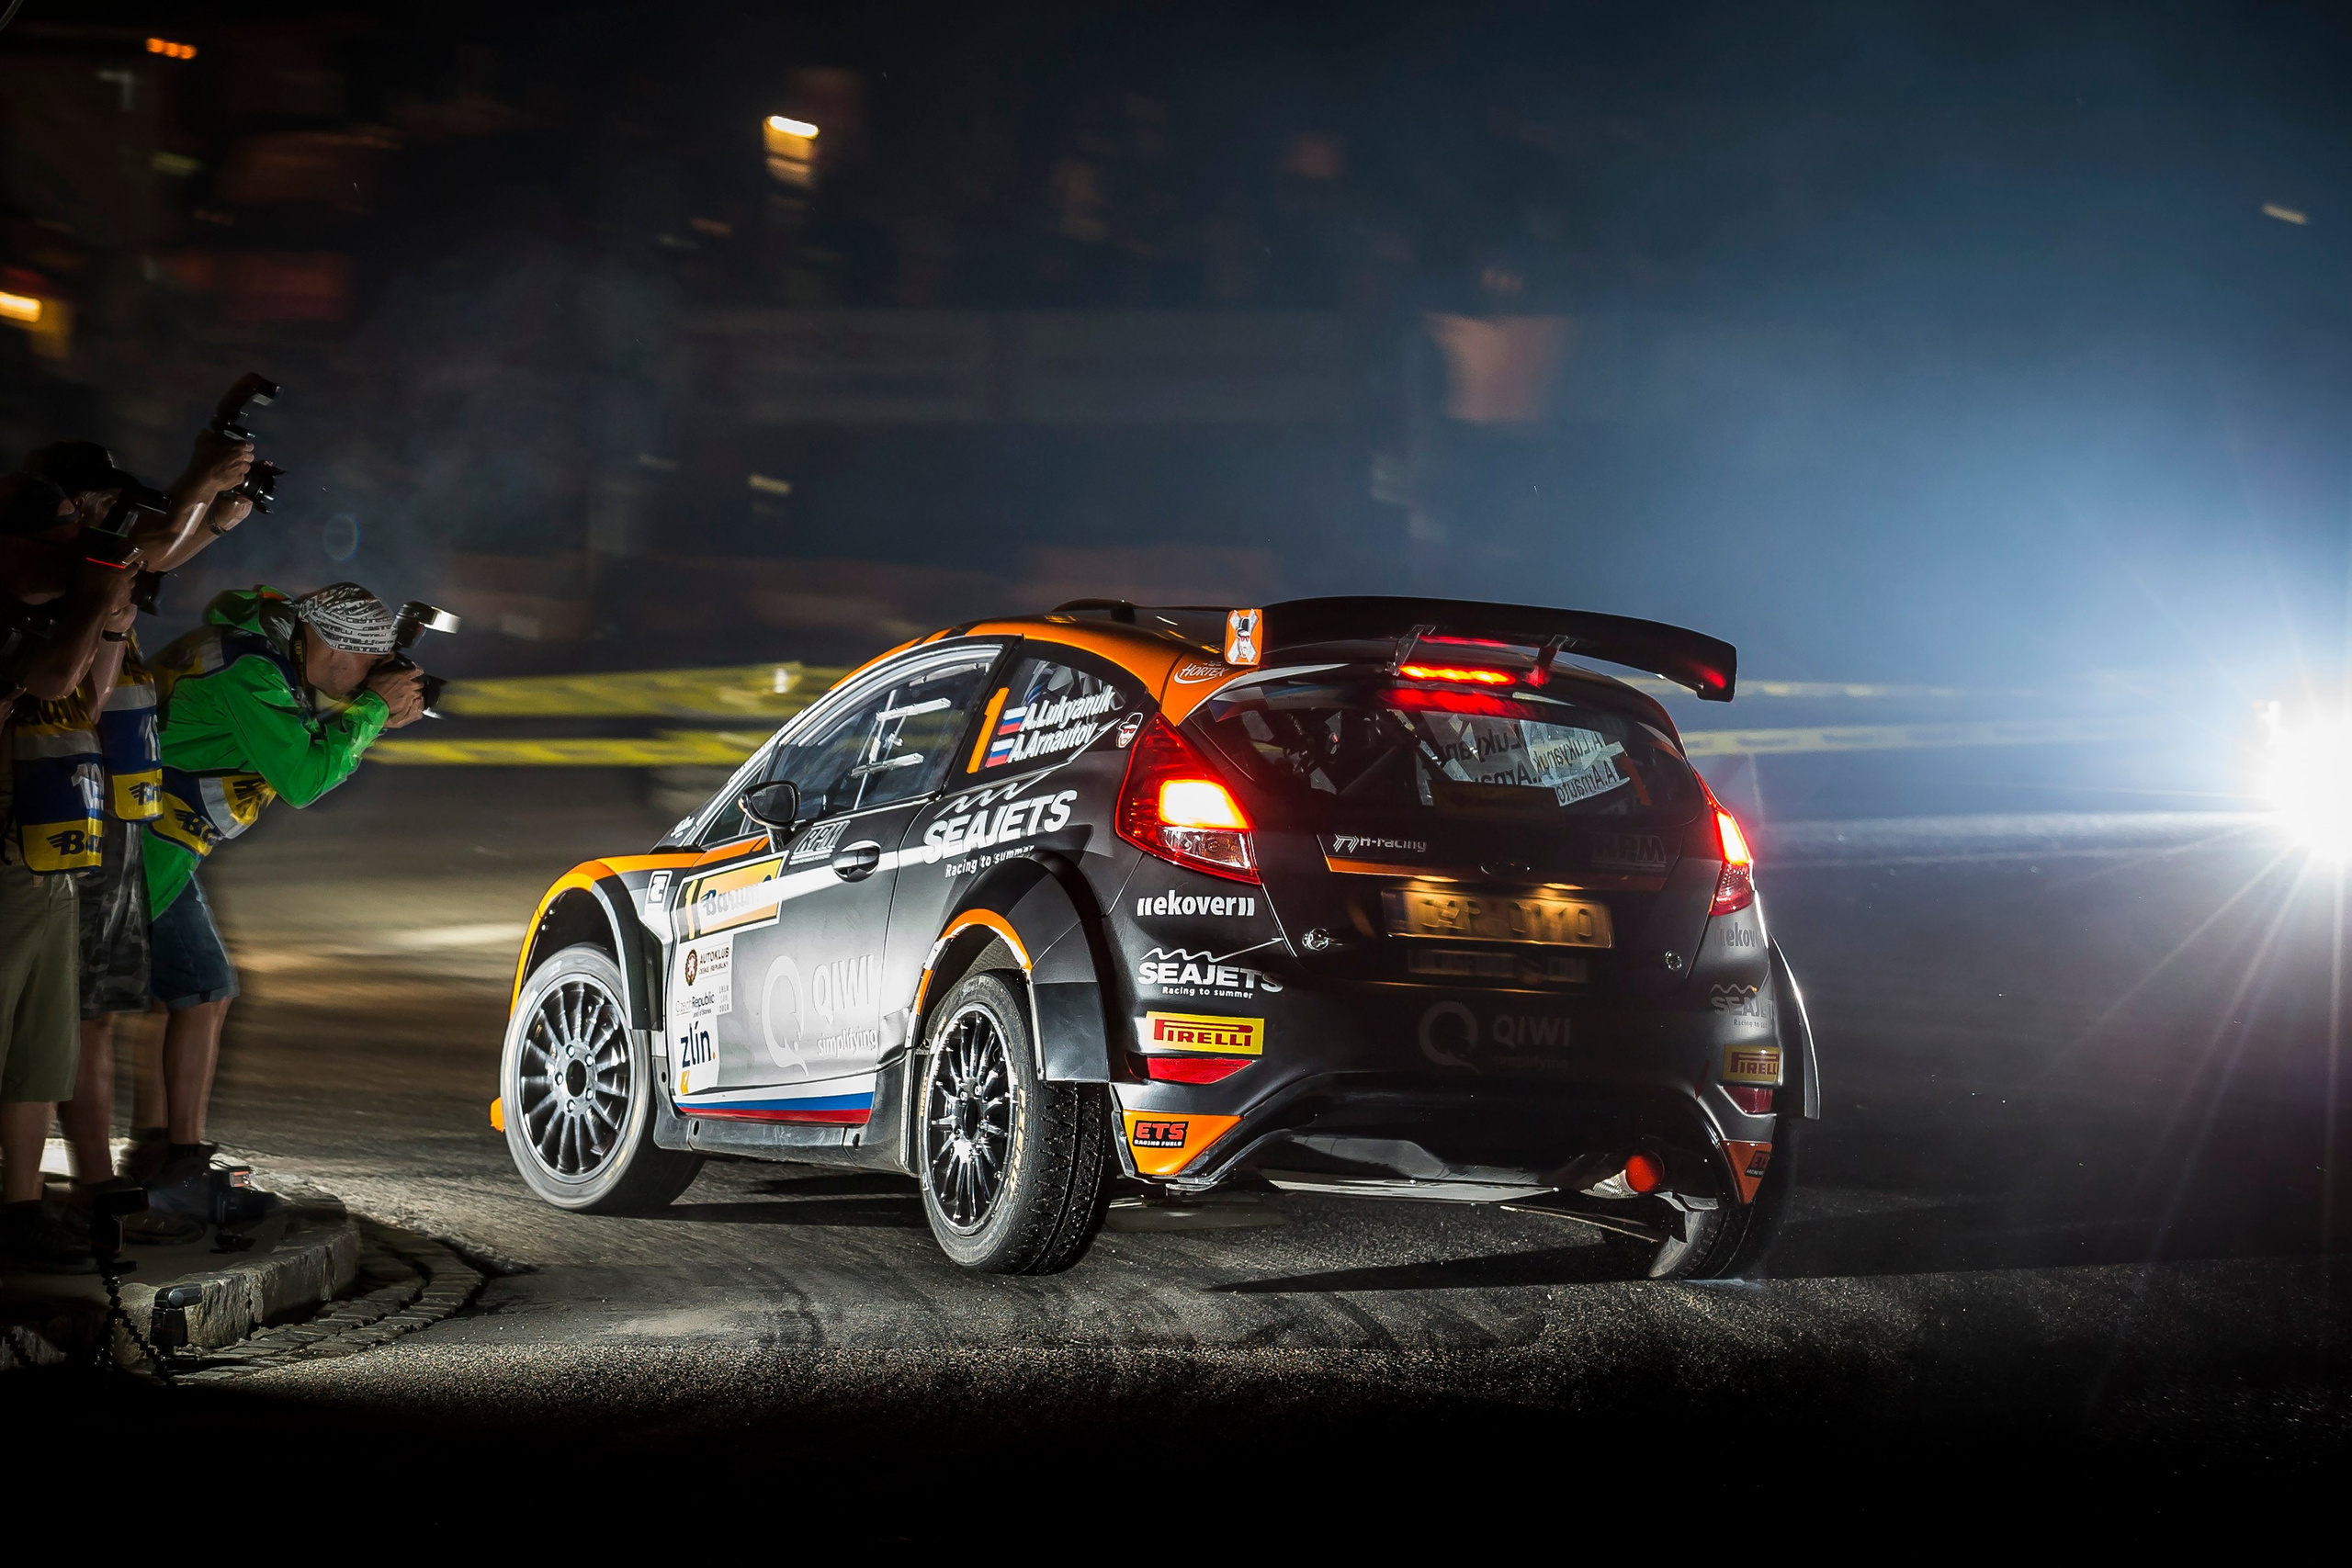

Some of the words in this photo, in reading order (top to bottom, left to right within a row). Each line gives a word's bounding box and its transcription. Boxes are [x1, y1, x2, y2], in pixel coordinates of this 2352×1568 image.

[1179, 663, 1229, 678] HORTEX
[1019, 685, 1115, 732] A.Lukyanuk
[967, 687, 1010, 773] 1
[1007, 720, 1099, 763] A.Arnautov
[921, 789, 1078, 864] SEAJETS
[945, 858, 978, 878] Racing
[980, 854, 991, 868] to
[994, 845, 1035, 864] summer
[699, 946, 729, 964] AUTOKLUB
[812, 953, 875, 1025] QIWI
[1137, 962, 1283, 993] SEAJETS
[1162, 986, 1194, 996] Racing
[1199, 987, 1210, 996] to
[1214, 989, 1253, 998] summer
[817, 1026, 877, 1058] simplifying
[1154, 1019, 1253, 1047] PIRELLI
[1492, 1014, 1571, 1050] QIWI
[1136, 1122, 1186, 1140] ETS
